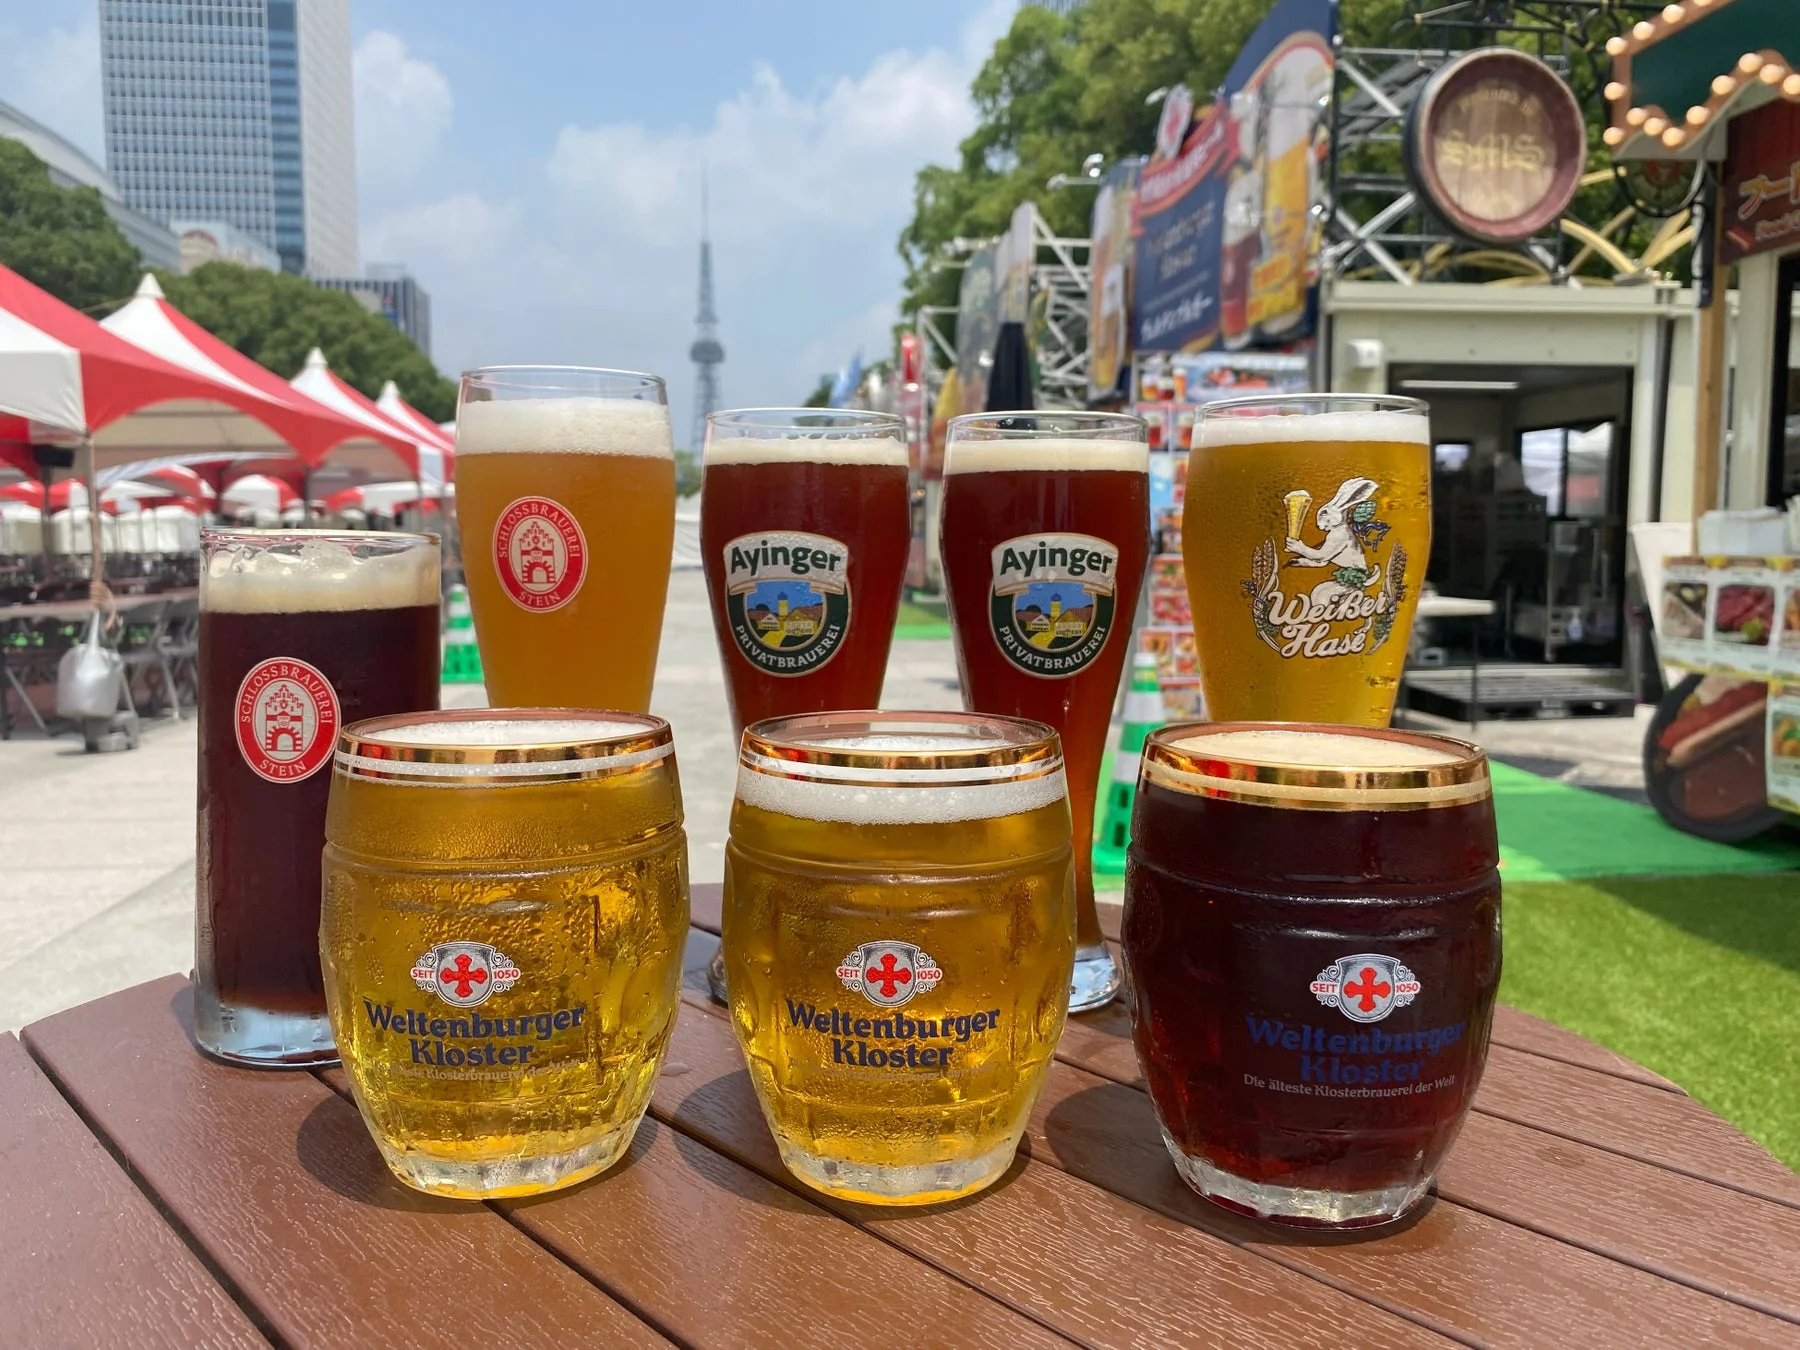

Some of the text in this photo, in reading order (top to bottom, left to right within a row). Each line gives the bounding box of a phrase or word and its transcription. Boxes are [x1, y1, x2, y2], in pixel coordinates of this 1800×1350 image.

[498, 503, 580, 558] SCHLOSSBRAUEREI
[731, 540, 841, 576] Ayinger
[1000, 541, 1113, 577] Ayinger
[519, 591, 561, 607] STEIN
[1267, 590, 1388, 626] Weißer
[735, 624, 841, 669] PRIVATBRAUEREI
[999, 626, 1106, 670] PRIVATBRAUEREI
[1280, 622, 1367, 659] Hase
[241, 664, 333, 724] SCHLOSSBRAUEREI
[260, 759, 307, 777] STEIN
[412, 968, 520, 980] SEIT 1050
[837, 967, 941, 980] SEIT 1050
[1312, 983, 1420, 994] SEIT 1050
[364, 998, 586, 1040] Weltenburger
[785, 999, 1001, 1042] Weltenburger
[1245, 1013, 1466, 1058] Weltenburger
[409, 1039, 535, 1067] Kloster
[831, 1038, 955, 1068] Kloster
[1301, 1055, 1425, 1085] Kloster
[1243, 1073, 1455, 1098] Die älteste Klosterbrauerei der Welt
